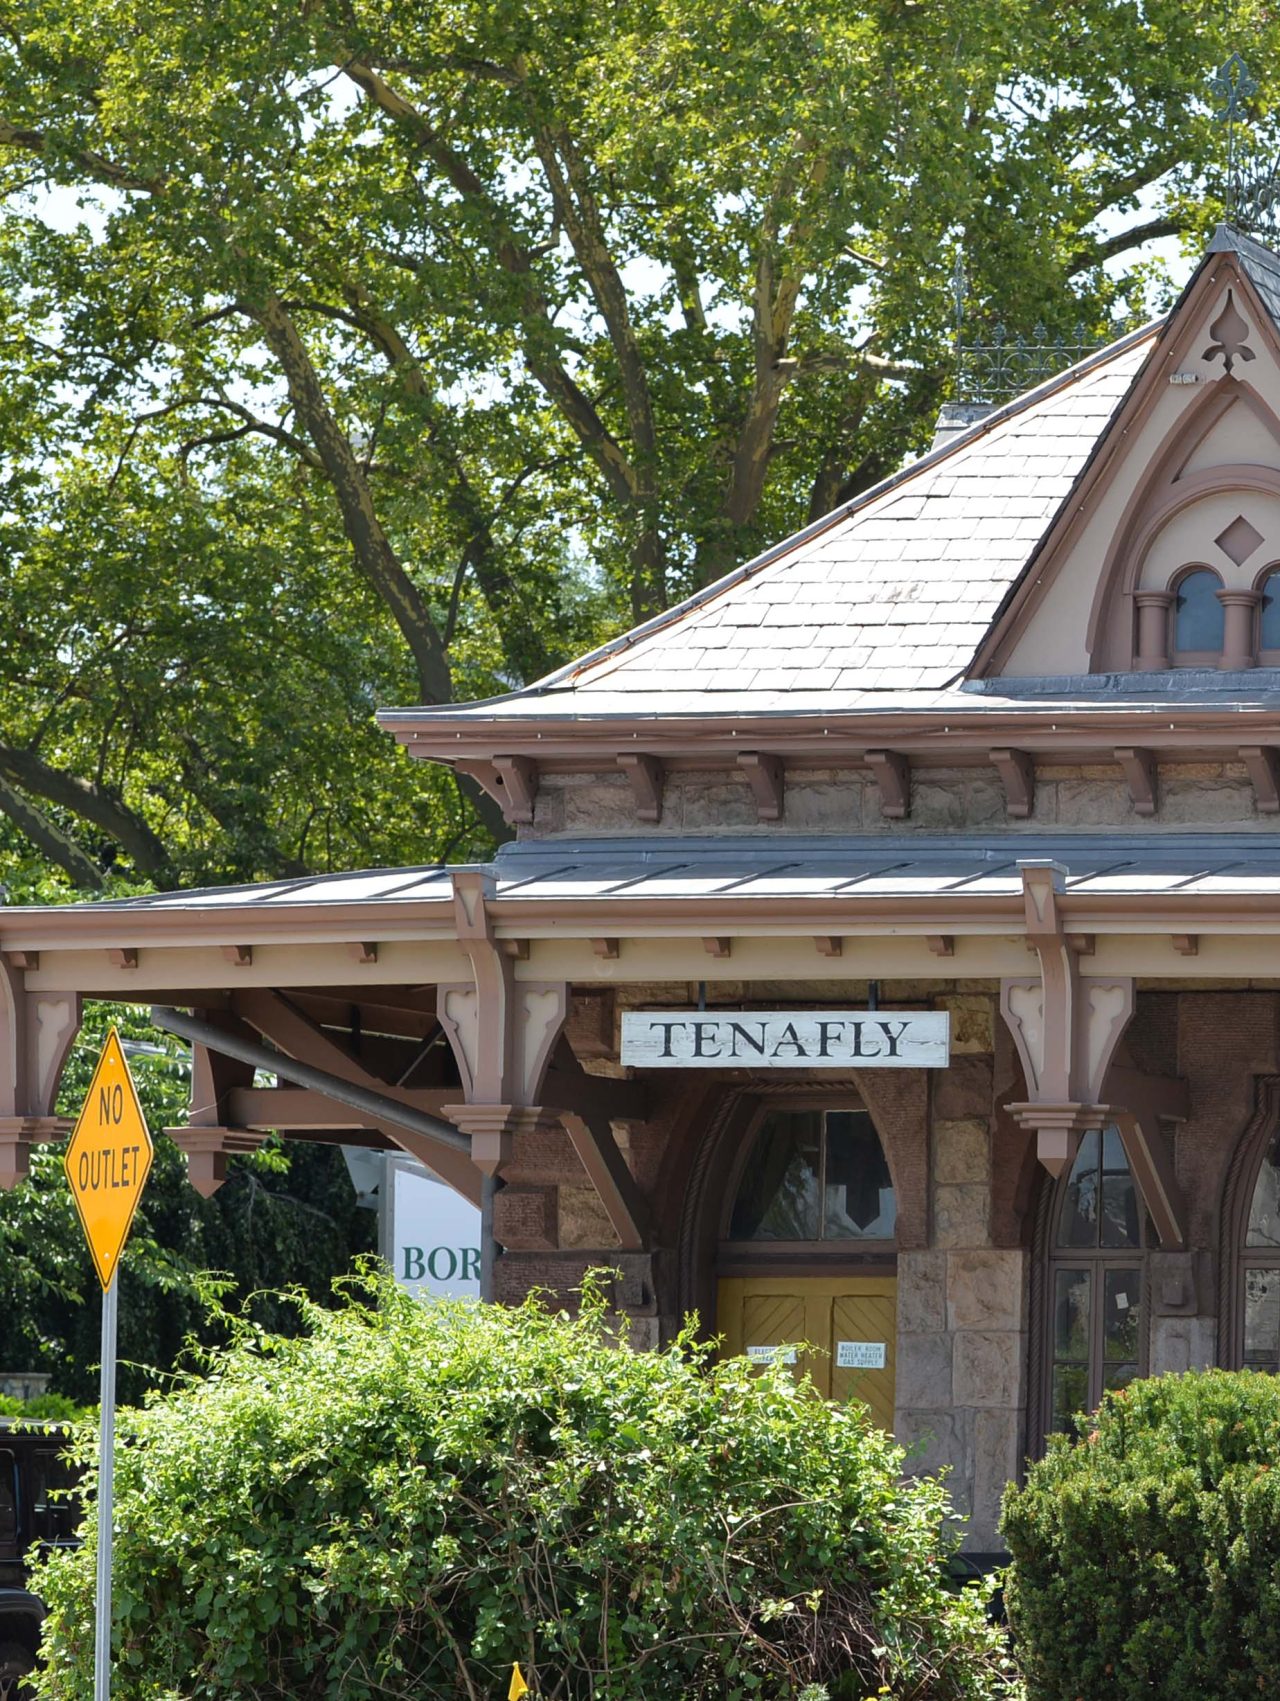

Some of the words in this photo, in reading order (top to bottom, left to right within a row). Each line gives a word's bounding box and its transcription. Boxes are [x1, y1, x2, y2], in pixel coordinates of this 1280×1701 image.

[650, 1021, 913, 1058] TENAFLY
[99, 1083, 123, 1126] NO
[79, 1145, 140, 1192] OUTLET
[401, 1246, 481, 1281] BOR
